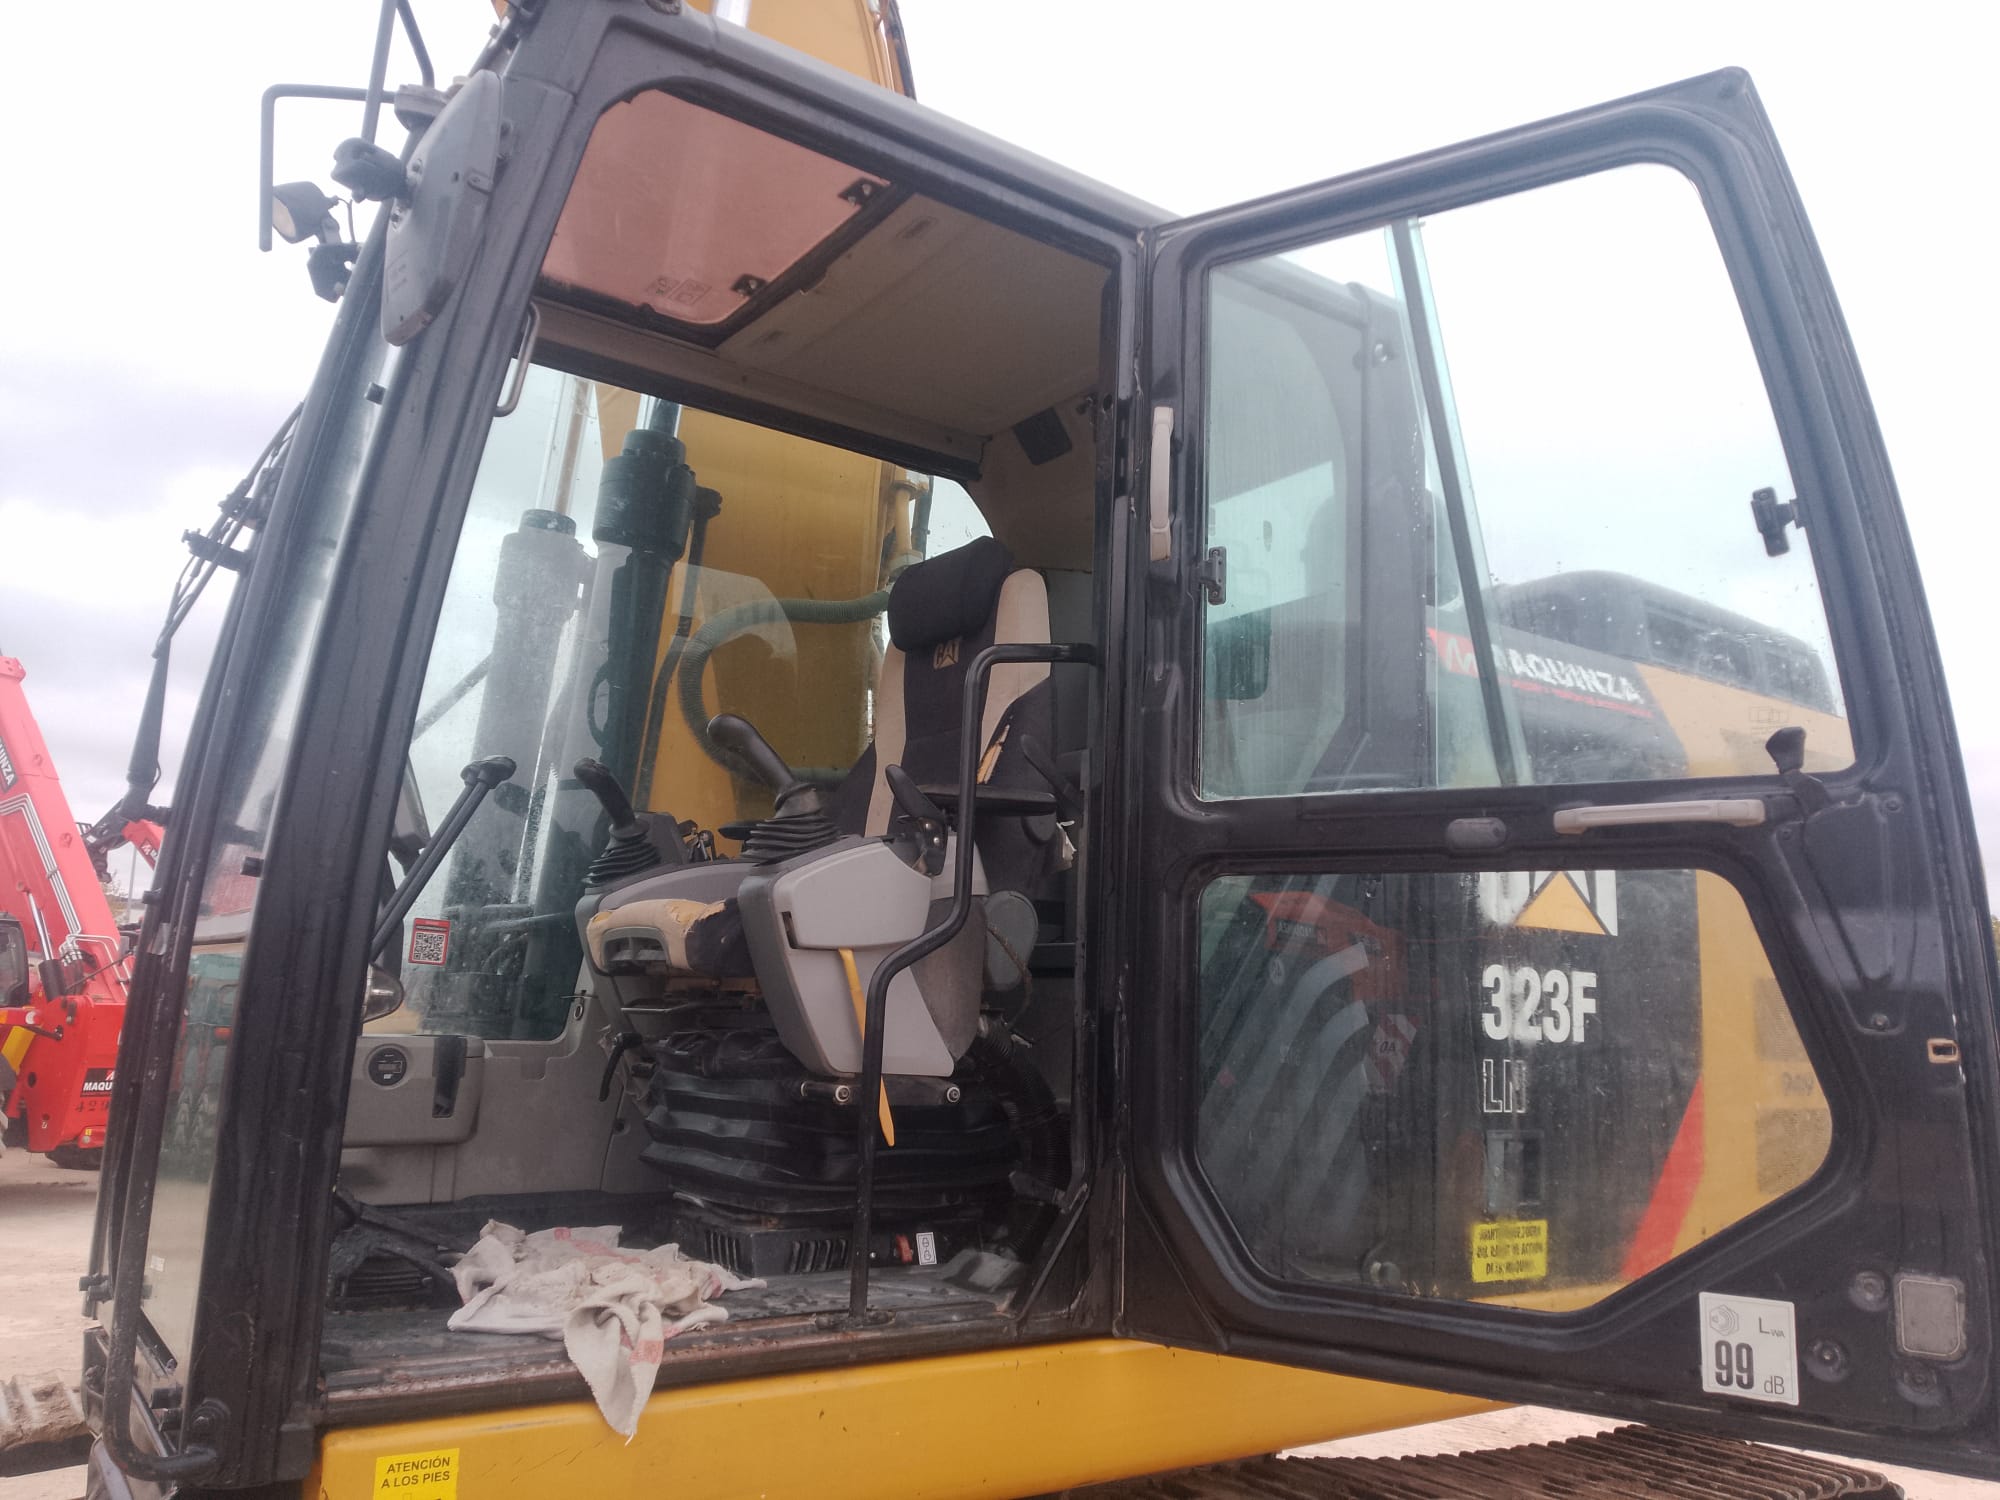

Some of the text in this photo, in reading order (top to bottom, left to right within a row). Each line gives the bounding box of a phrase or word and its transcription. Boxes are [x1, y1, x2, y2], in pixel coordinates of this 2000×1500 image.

[1482, 964, 1597, 1043] 323F
[1715, 1340, 1785, 1395] 99 dB
[381, 1470, 450, 1489] A LOS PIES
[387, 1456, 450, 1474] ATENCIÓN
